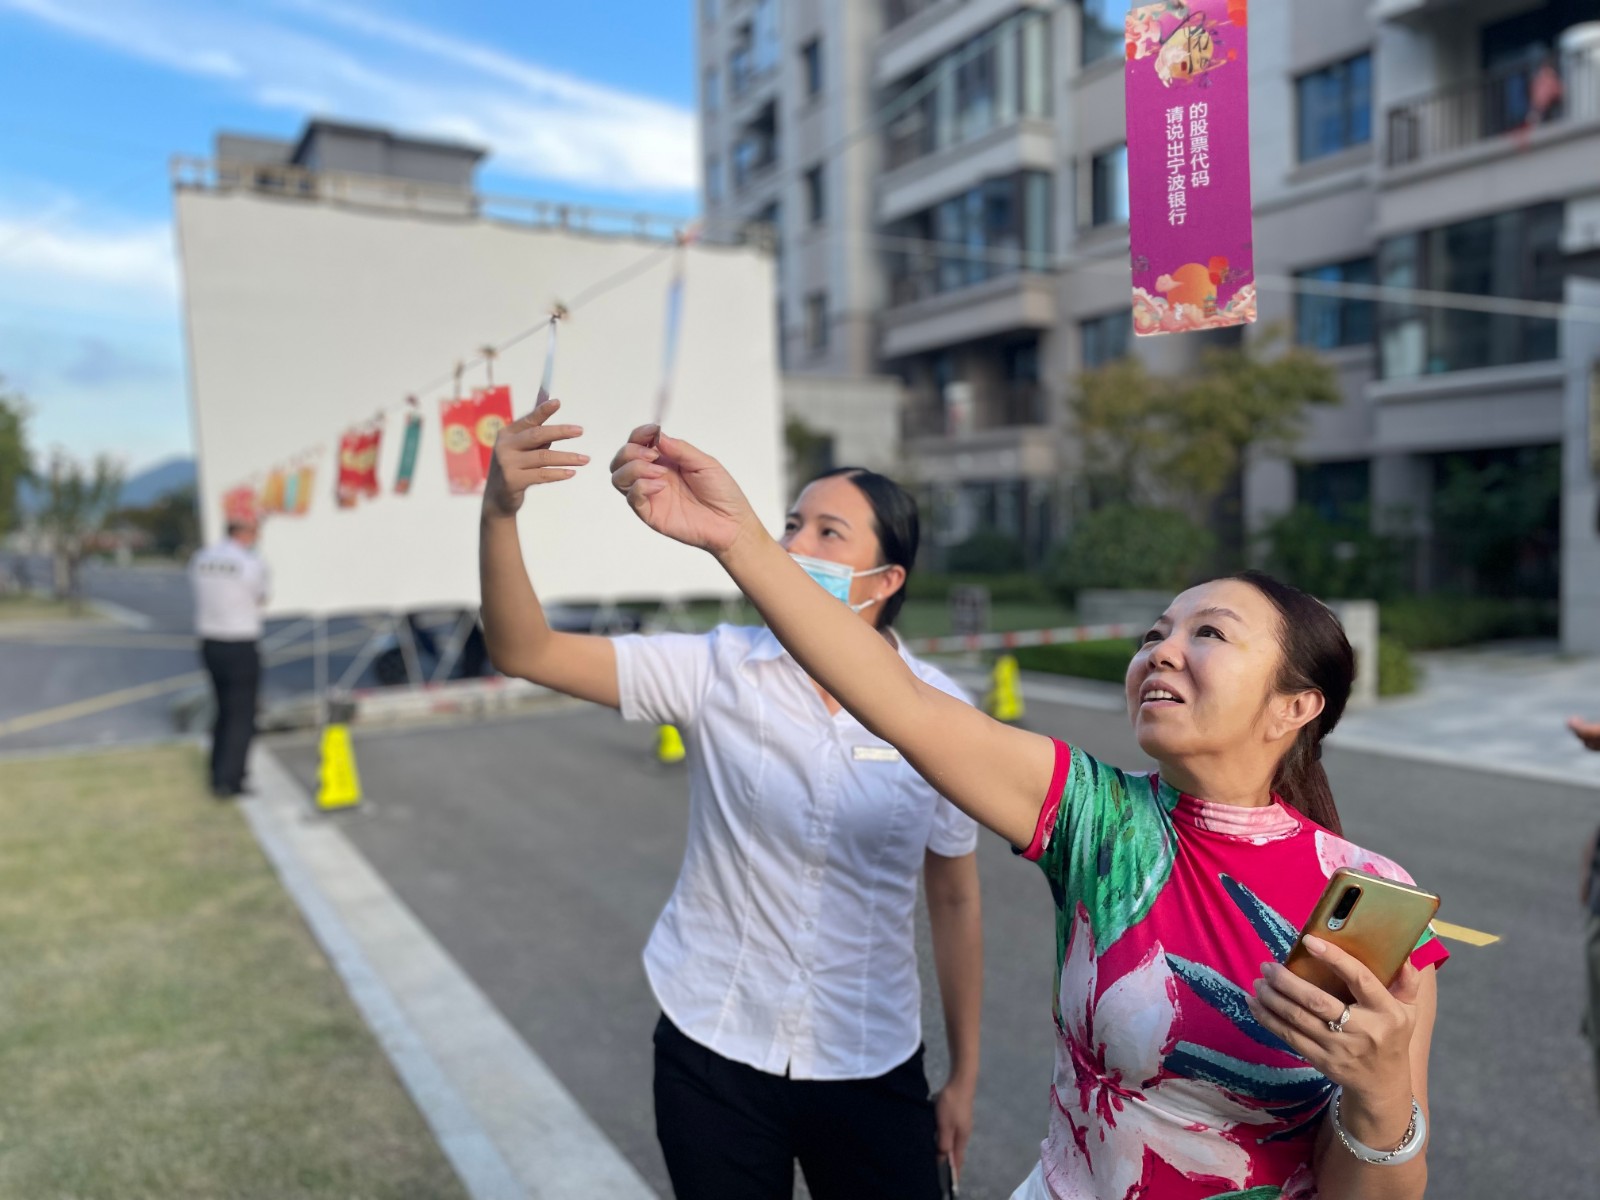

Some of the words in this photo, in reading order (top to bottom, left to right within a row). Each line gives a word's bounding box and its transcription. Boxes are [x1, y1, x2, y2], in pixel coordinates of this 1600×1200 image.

[1165, 106, 1187, 226] 请说出宁波银行
[1189, 101, 1210, 188] 的股票代码
